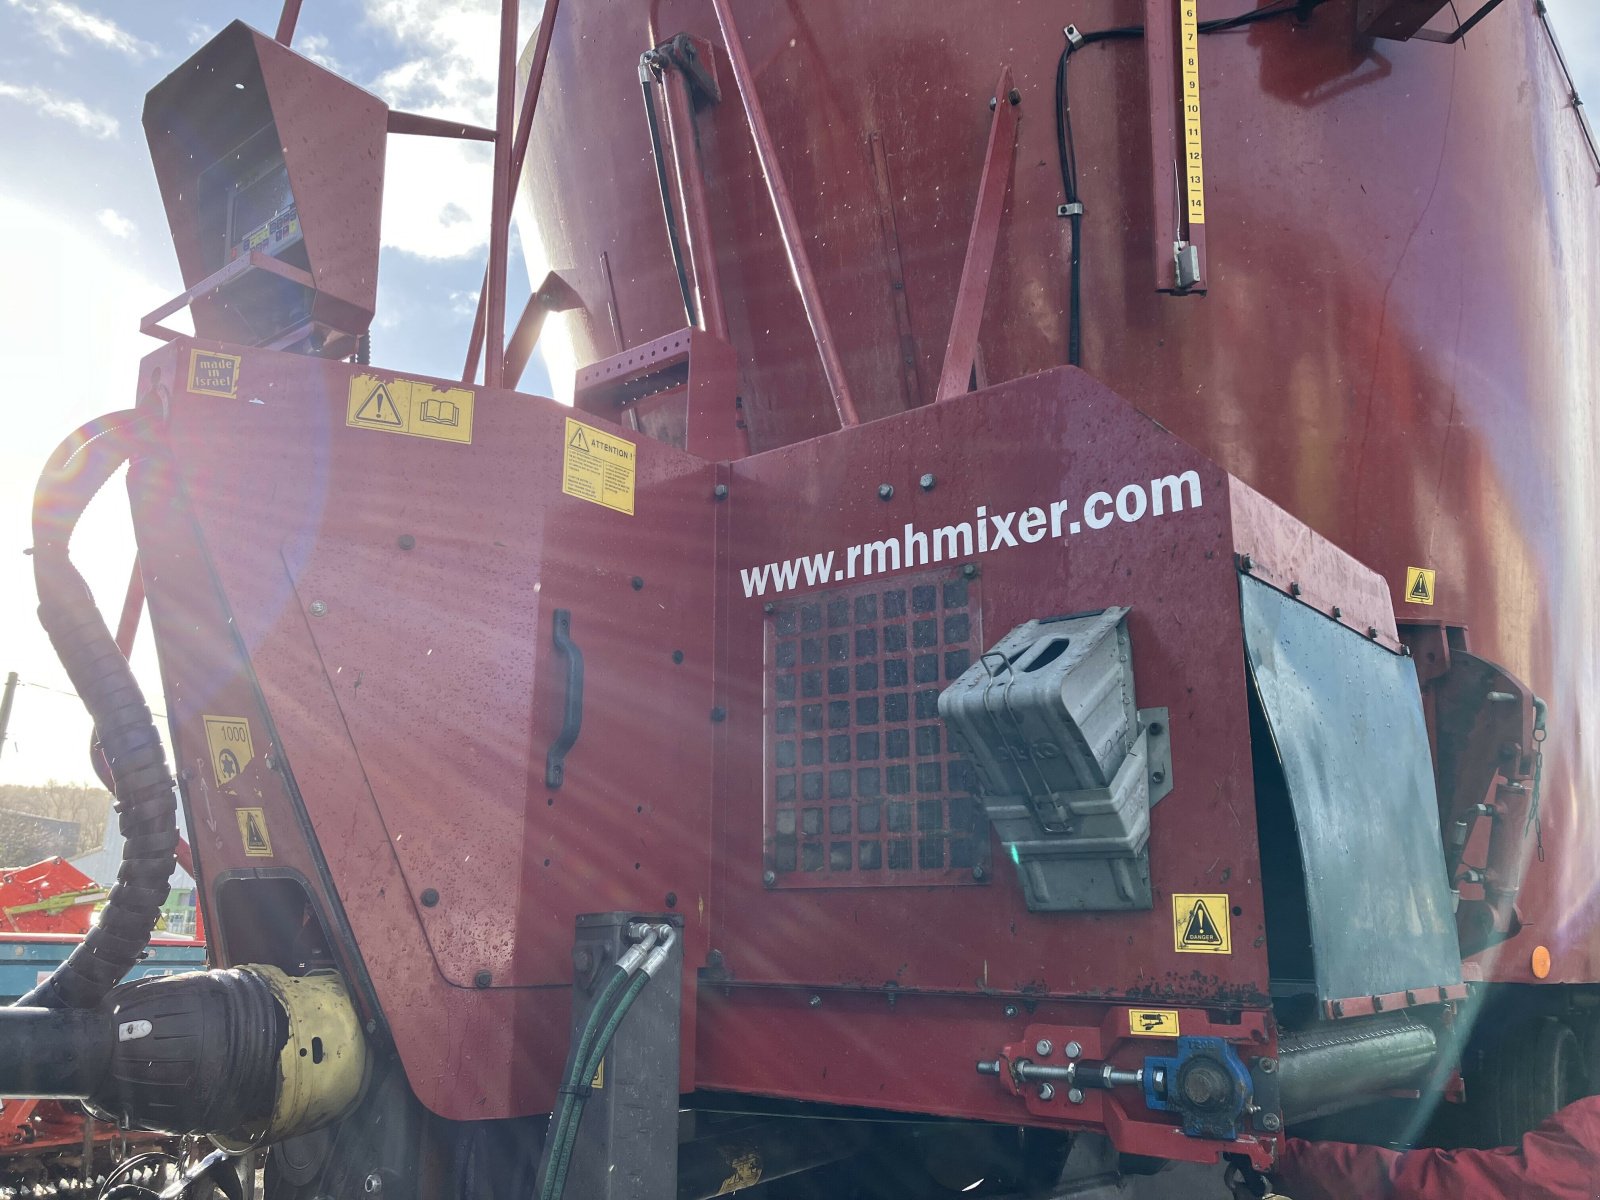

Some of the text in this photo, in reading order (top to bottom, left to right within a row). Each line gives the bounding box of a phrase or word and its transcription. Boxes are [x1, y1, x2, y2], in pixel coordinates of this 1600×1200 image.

[1186, 9, 1192, 17] 6
[200, 359, 232, 368] made
[195, 376, 230, 386] Israel
[591, 439, 628, 459] ATTENTION
[739, 470, 1203, 599] www.rmhmixer.com
[221, 725, 246, 743] 1000
